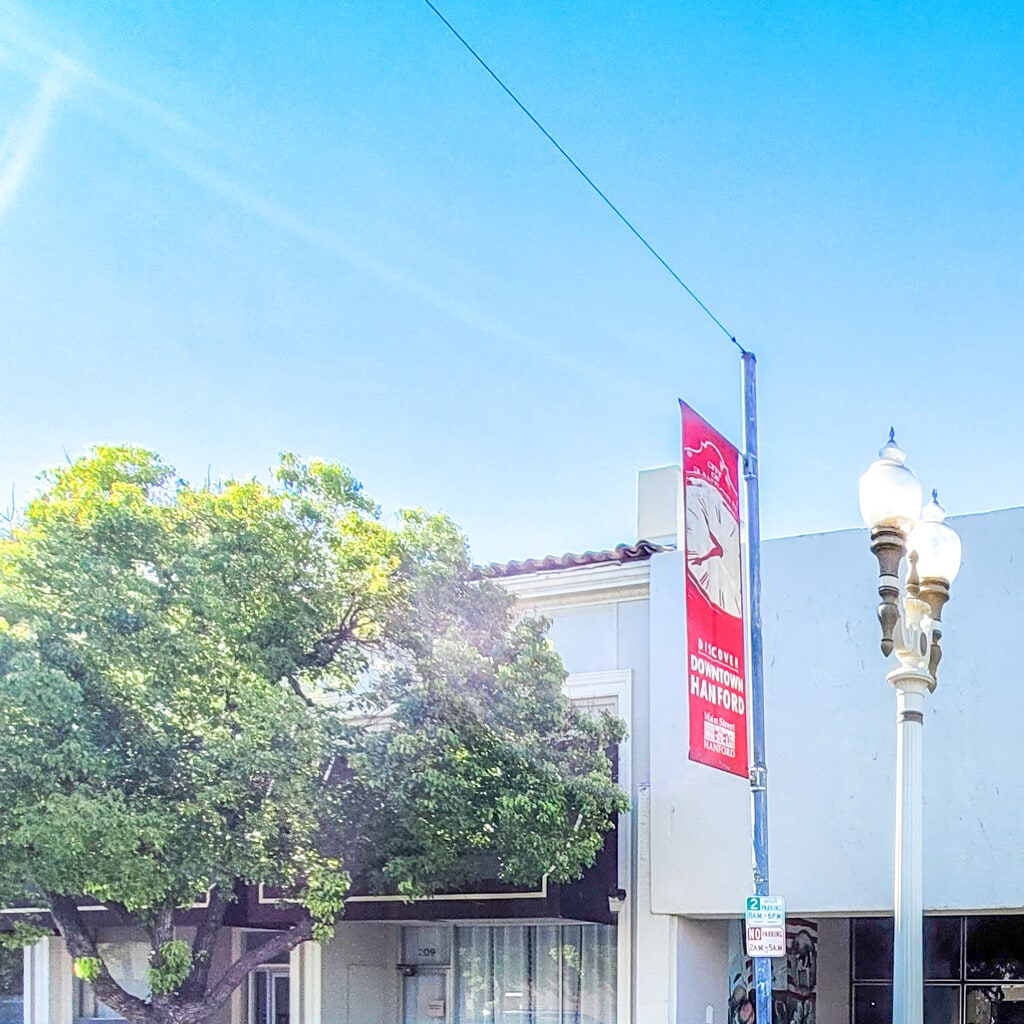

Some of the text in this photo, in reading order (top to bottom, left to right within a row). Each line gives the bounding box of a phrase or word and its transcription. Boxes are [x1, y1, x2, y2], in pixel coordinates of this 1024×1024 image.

[698, 638, 739, 669] DISCOVER
[690, 653, 744, 694] DOWNTOWN
[690, 674, 745, 715] HANFORD
[750, 898, 759, 910] 2
[749, 928, 761, 940] NO
[762, 930, 783, 938] PARKING
